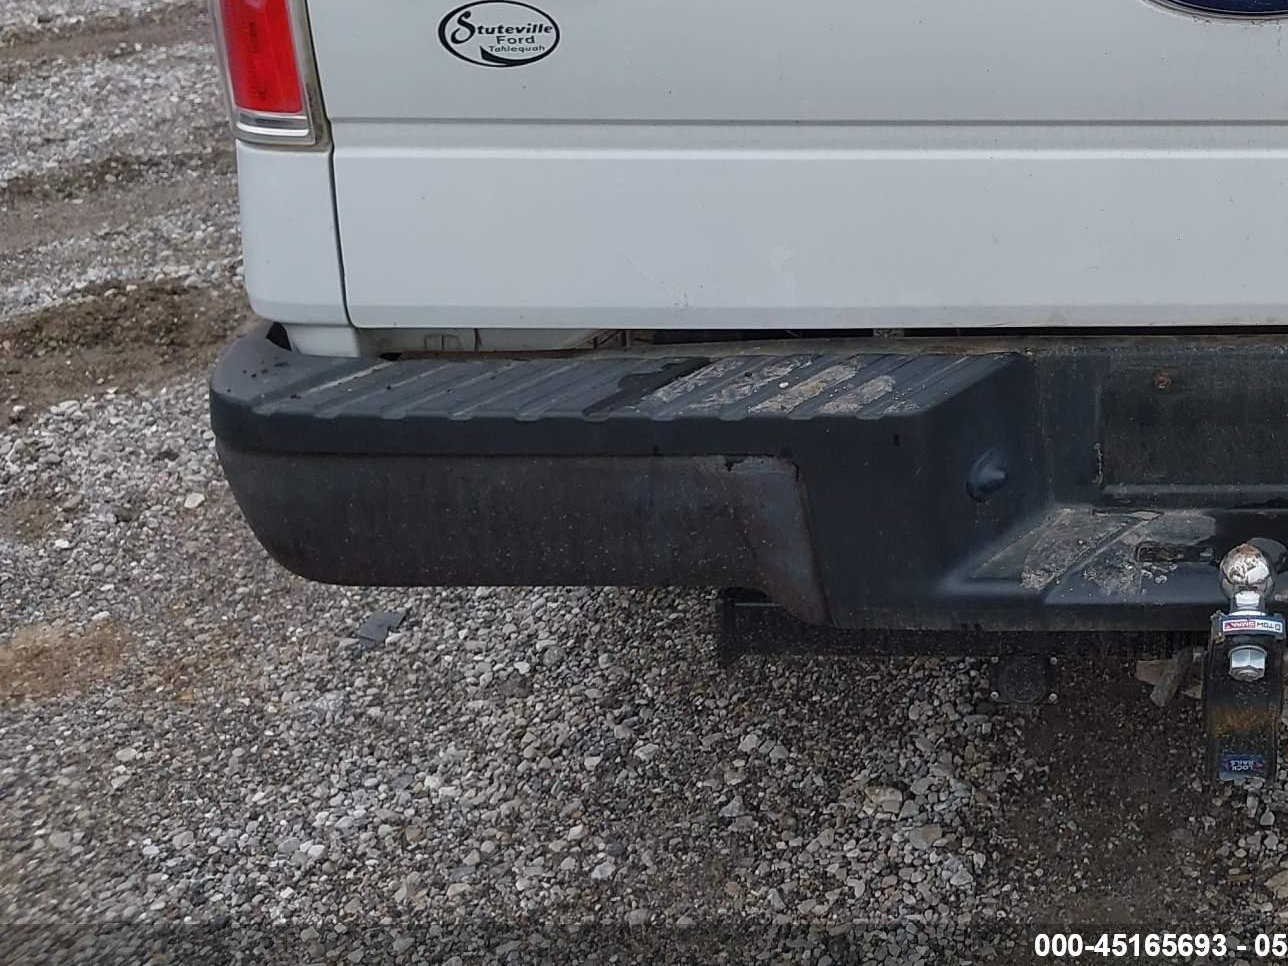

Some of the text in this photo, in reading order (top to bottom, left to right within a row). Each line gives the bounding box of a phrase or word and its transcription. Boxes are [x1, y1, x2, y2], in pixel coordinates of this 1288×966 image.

[450, 10, 553, 45] Stuteville
[496, 35, 536, 45] Ford
[488, 45, 546, 53] Tahlequah
